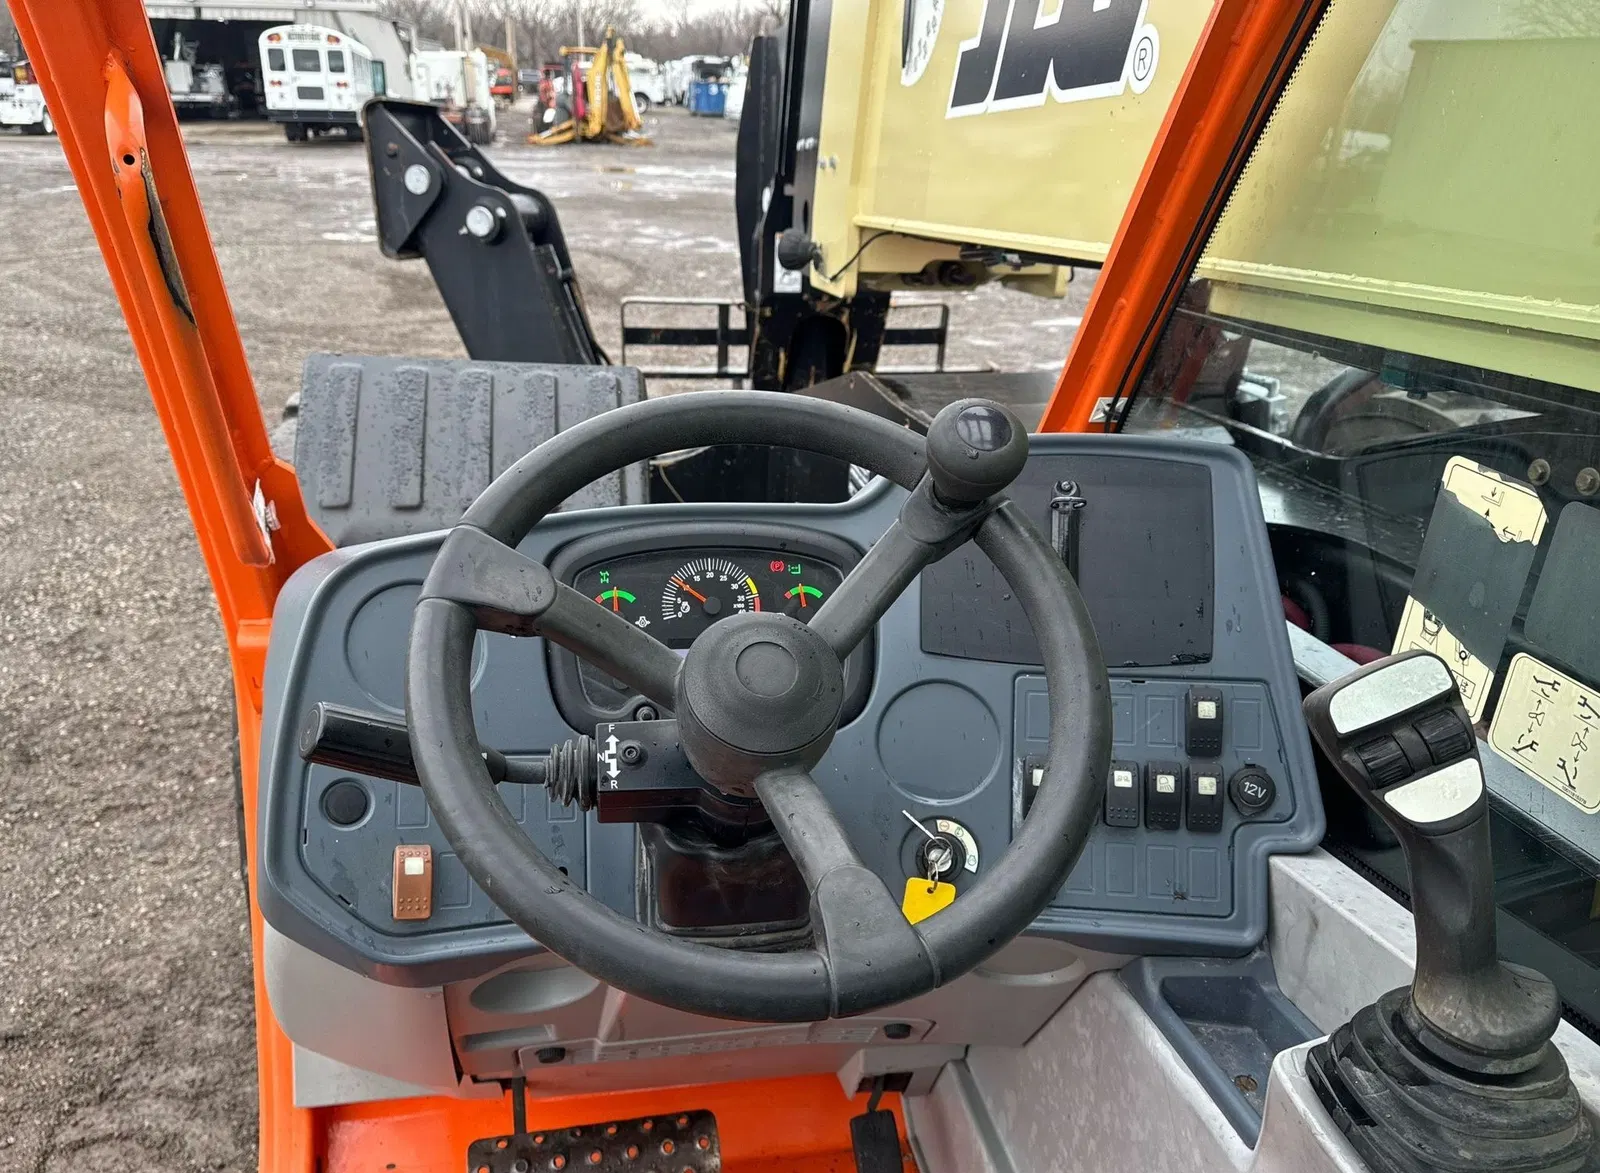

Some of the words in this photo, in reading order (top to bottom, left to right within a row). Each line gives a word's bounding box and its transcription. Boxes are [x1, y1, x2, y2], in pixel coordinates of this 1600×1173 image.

[608, 724, 615, 733] F
[596, 752, 605, 762] N
[610, 780, 619, 789] R
[1244, 781, 1267, 798] 12V
